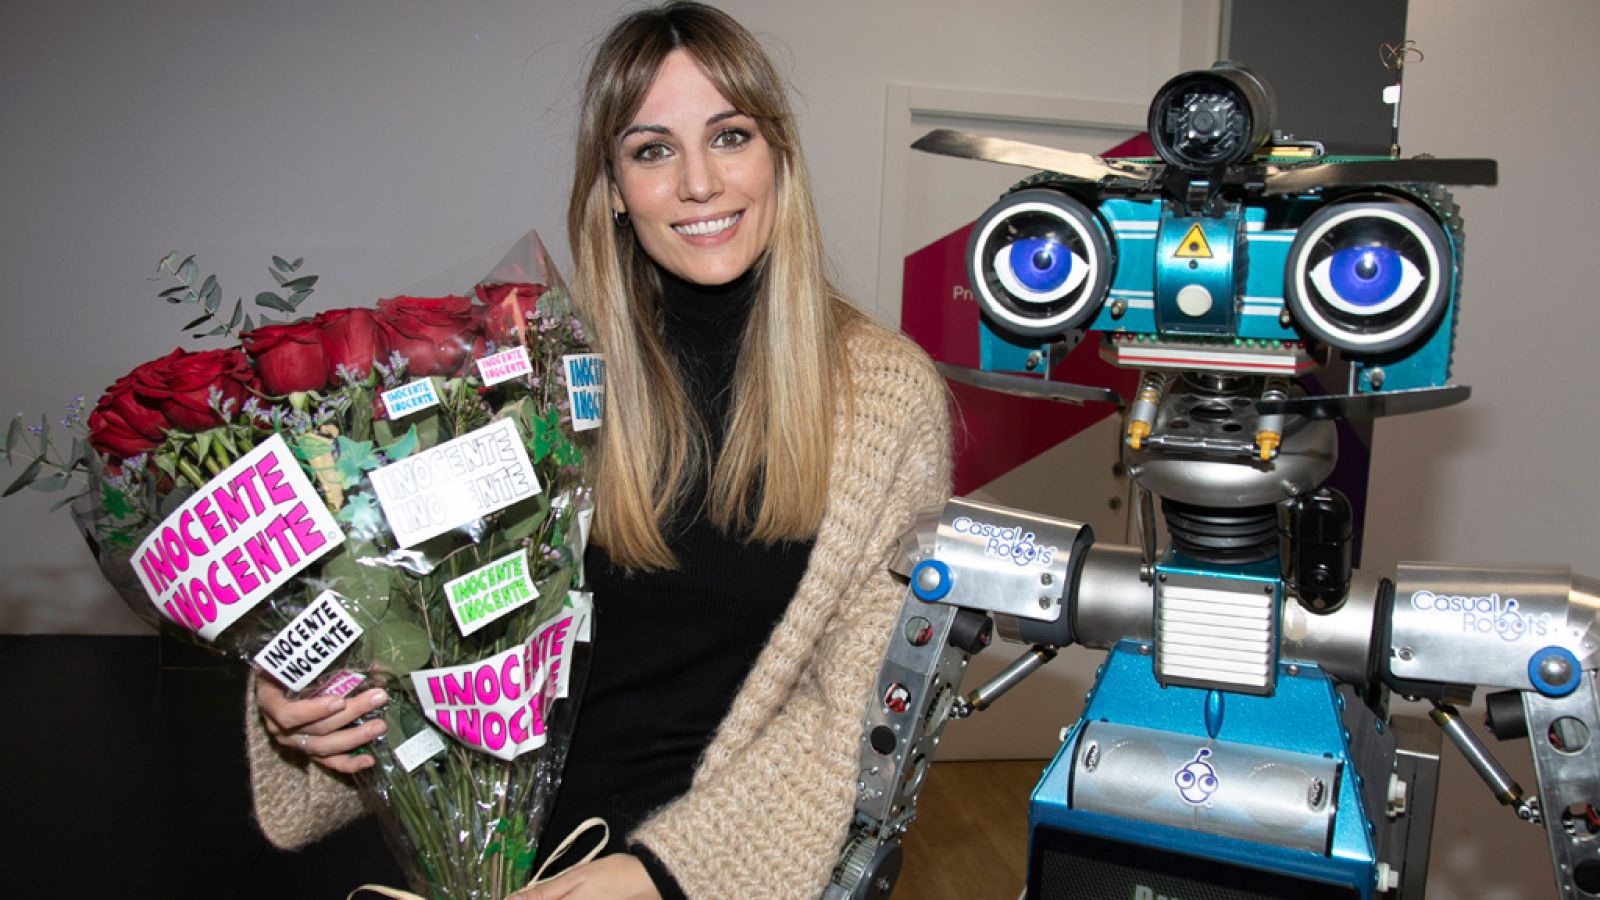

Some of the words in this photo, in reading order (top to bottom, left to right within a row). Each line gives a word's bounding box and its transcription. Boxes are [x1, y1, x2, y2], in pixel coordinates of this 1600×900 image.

[139, 451, 297, 597] INOCENTE
[954, 518, 1021, 542] Casual
[164, 501, 327, 631] INOCENTE
[451, 555, 525, 603] INOCENTE
[457, 577, 530, 625] INOCENTE
[1413, 591, 1498, 613] Casual
[264, 600, 337, 669] INOCENTE
[281, 619, 354, 683] INOCENTE
